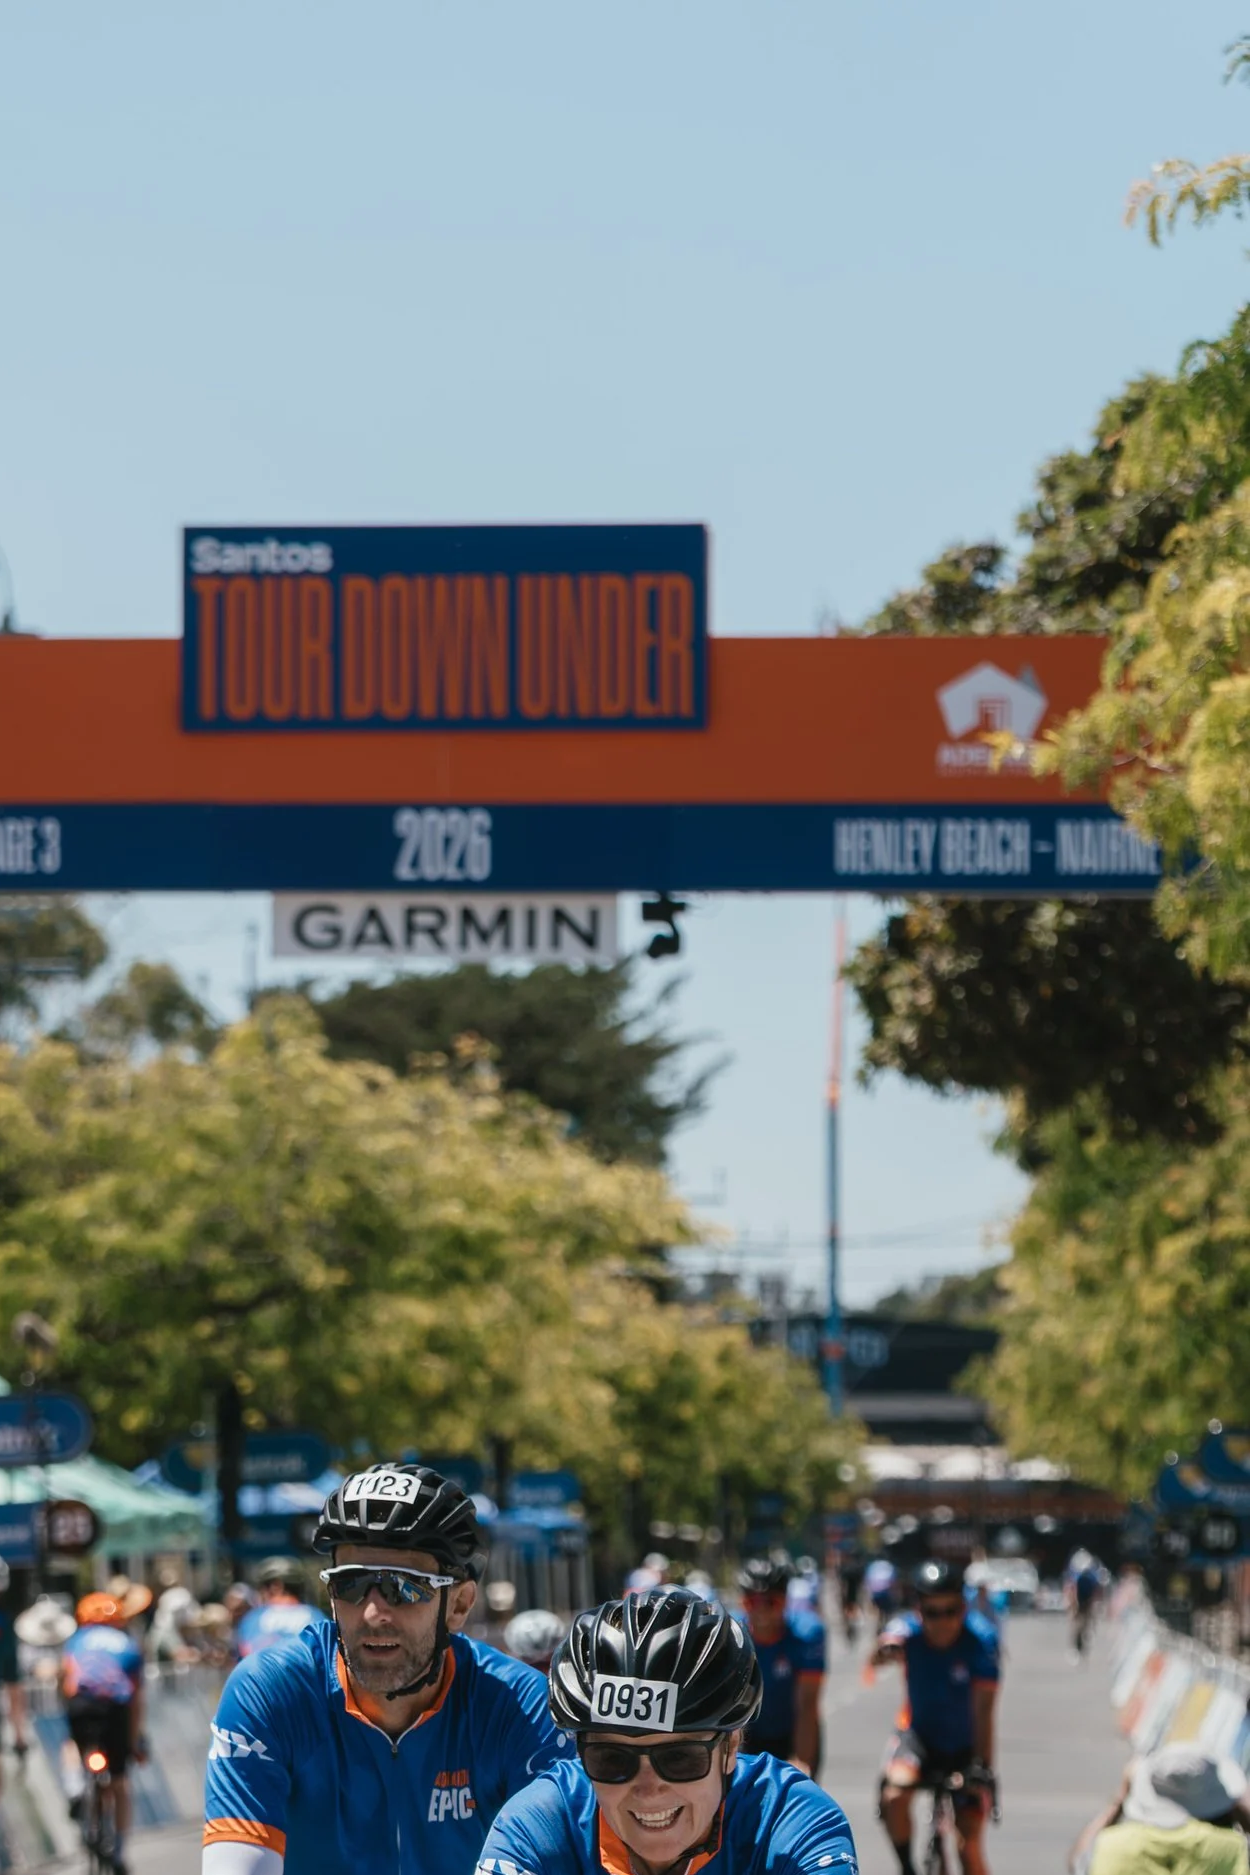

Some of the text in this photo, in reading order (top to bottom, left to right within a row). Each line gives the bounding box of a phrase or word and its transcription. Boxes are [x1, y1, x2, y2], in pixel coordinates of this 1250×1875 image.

[191, 537, 333, 573] Santos
[190, 572, 696, 722] TOUR DOWN UNDER
[40, 817, 62, 874] 3
[393, 806, 493, 881] 2026
[834, 817, 937, 875] HENLEY
[939, 817, 1031, 876] BEACH
[292, 903, 601, 953] GARMIN
[597, 1681, 671, 1724] 0931
[428, 1787, 474, 1822] EPIC
